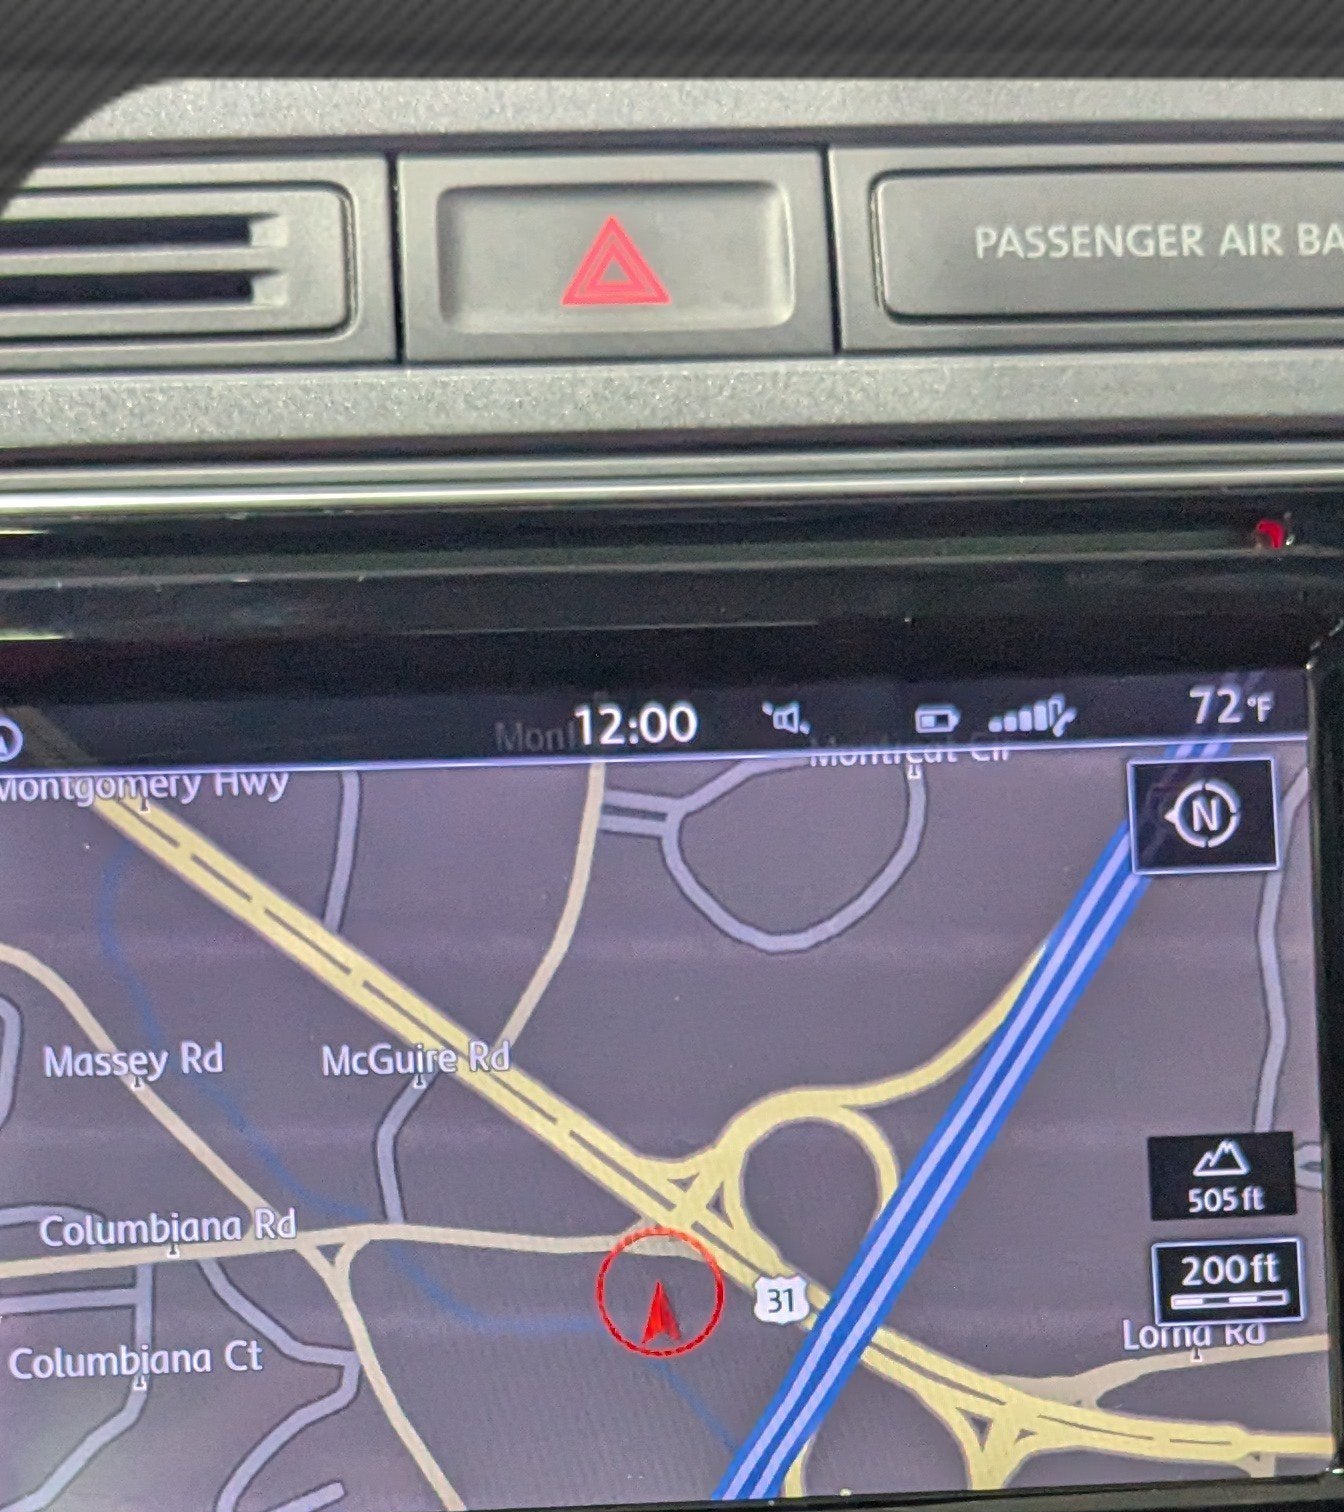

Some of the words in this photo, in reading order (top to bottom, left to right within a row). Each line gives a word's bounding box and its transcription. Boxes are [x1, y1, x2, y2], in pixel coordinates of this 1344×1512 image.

[974, 222, 1204, 259] PASSENGER
[1218, 222, 1283, 256] AIR
[573, 701, 697, 748] 12:00
[214, 768, 290, 803] Hwy
[44, 1045, 169, 1081] Massey
[181, 1041, 224, 1074] Rd
[321, 1045, 458, 1077] McGuire
[468, 1041, 511, 1071] Rd
[1188, 1187, 1239, 1213] 505
[40, 1212, 241, 1246] Columbiana
[255, 1207, 297, 1239] Rd
[767, 1288, 795, 1312] 31
[1123, 1319, 1212, 1350] Lorna
[1224, 1323, 1267, 1346] Rd
[9, 1344, 212, 1380] Columbiana
[225, 1340, 264, 1372] Ct
